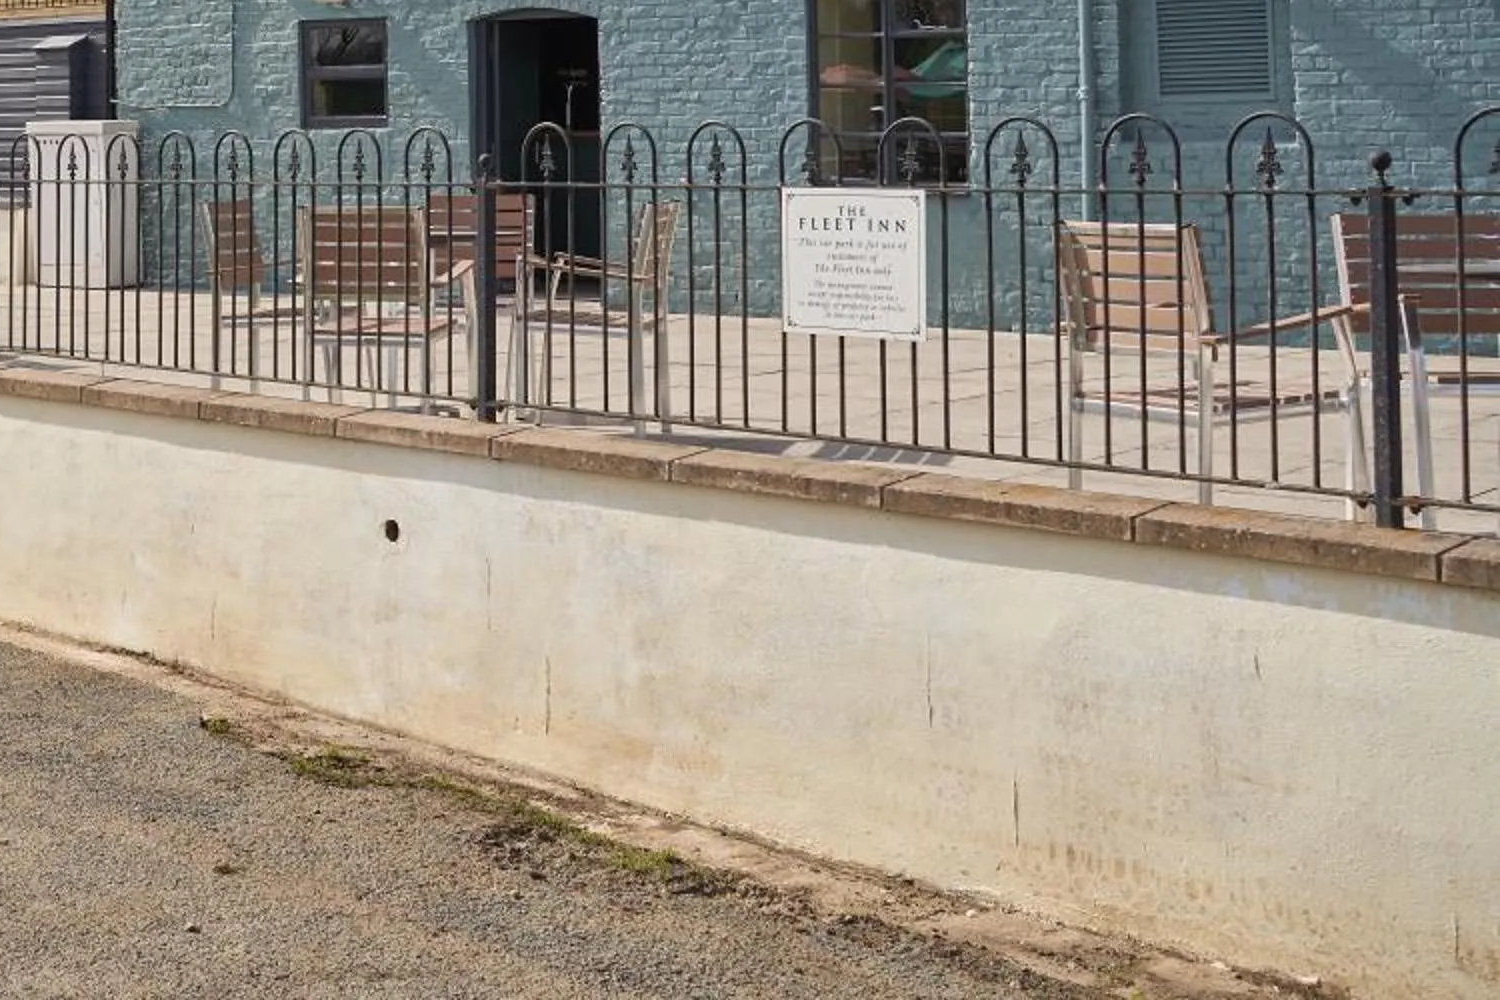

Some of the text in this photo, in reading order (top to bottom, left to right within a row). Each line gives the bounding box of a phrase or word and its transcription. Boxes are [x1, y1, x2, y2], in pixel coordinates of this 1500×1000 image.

[838, 205, 867, 217] THE
[799, 217, 907, 232] FLEET INN
